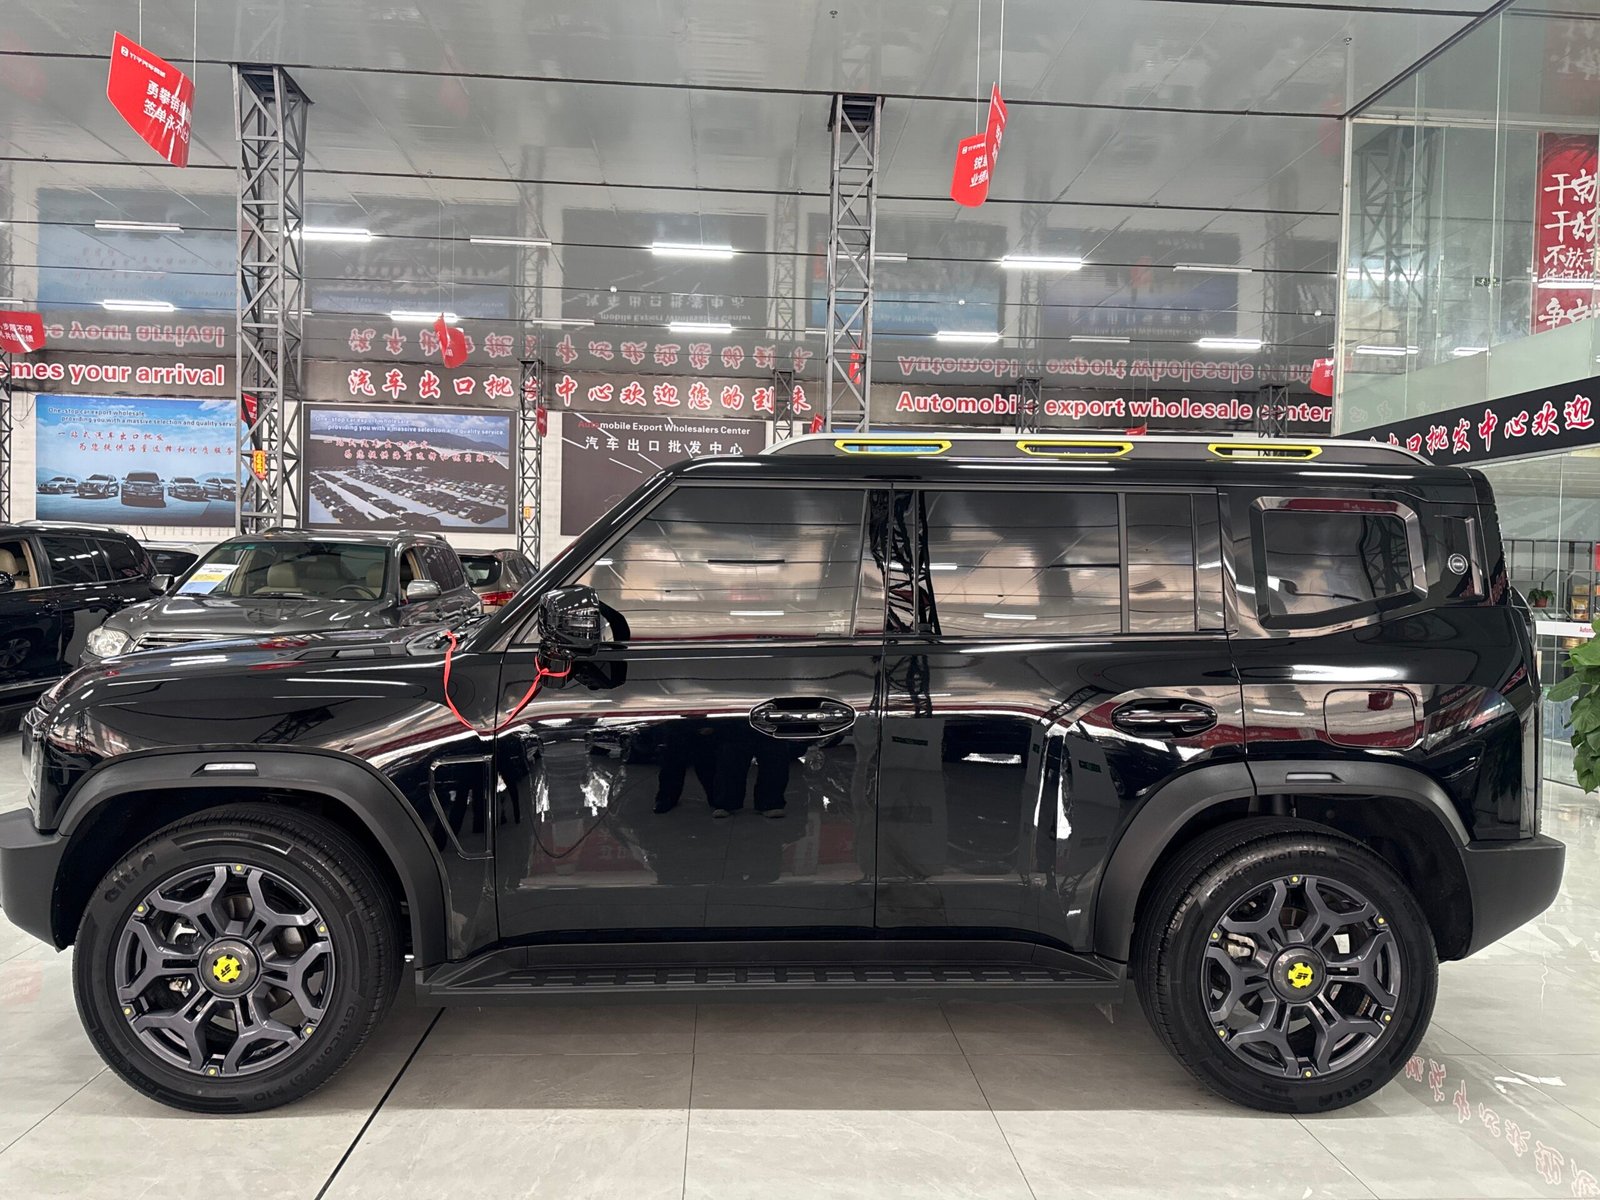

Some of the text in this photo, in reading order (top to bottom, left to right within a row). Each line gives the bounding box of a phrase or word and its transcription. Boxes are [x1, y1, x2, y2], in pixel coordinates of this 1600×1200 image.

[68, 363, 131, 385] your
[136, 363, 225, 386] arrival
[1045, 399, 1126, 420] export
[1130, 398, 1253, 419] wholesale
[327, 424, 358, 432] providing
[631, 422, 663, 433] Export
[664, 423, 720, 434] Wholesalers
[720, 426, 751, 435] Center
[586, 436, 743, 455] 汽车出口批发中心
